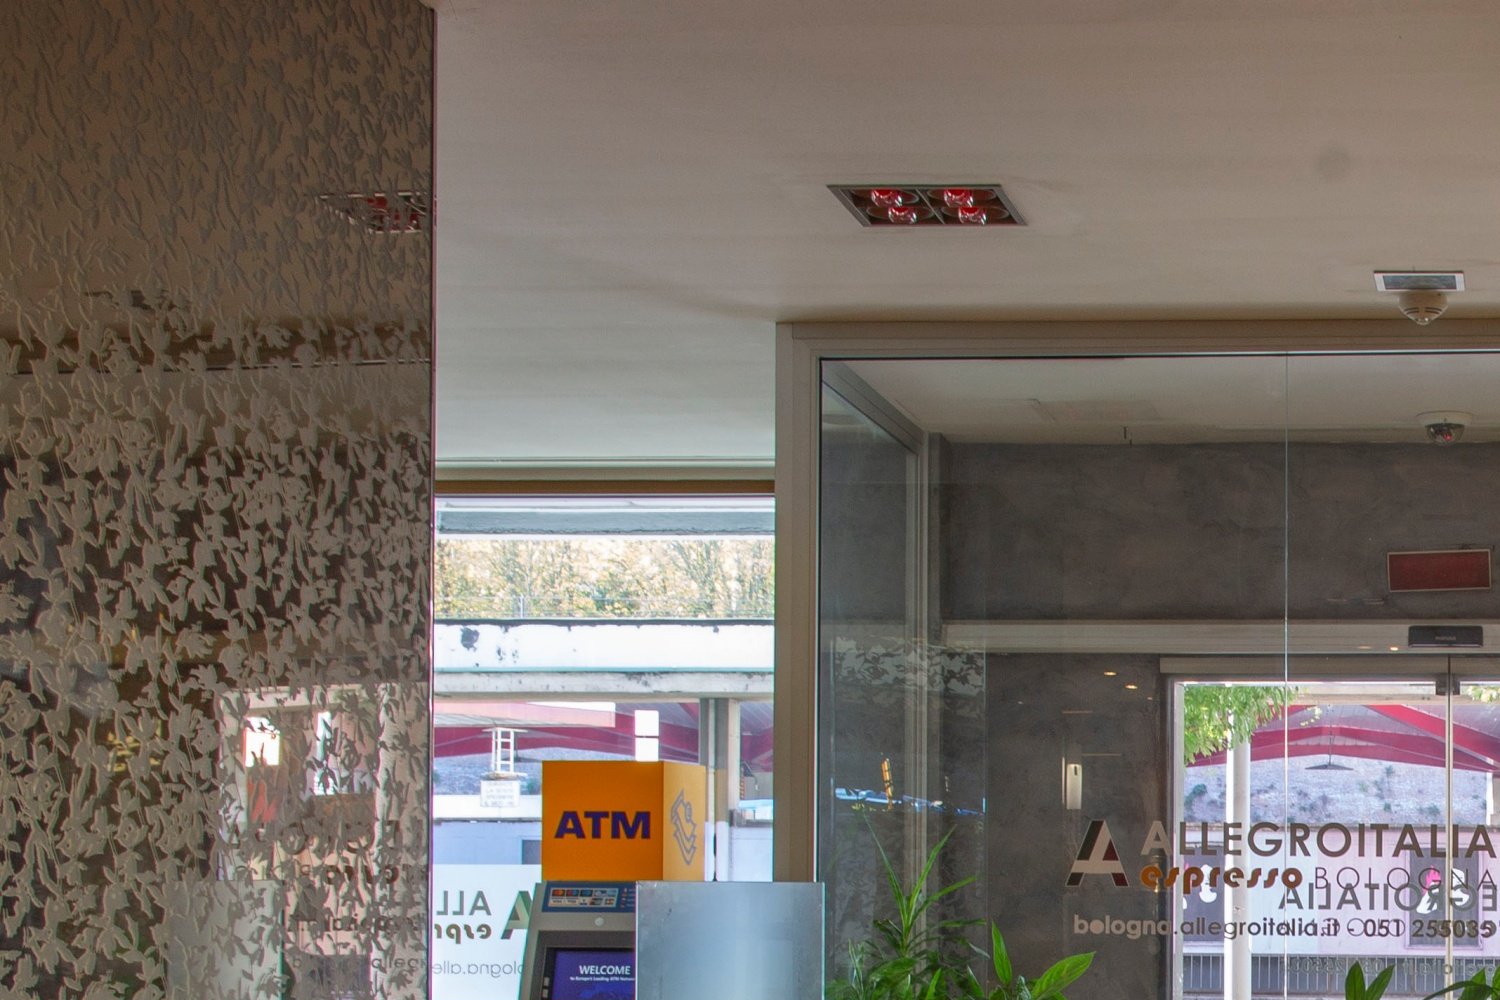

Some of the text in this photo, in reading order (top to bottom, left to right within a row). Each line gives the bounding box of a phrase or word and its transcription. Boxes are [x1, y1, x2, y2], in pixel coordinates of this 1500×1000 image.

[554, 810, 652, 840] ATM
[1141, 820, 1497, 858] ALLEGROITALIA
[1140, 866, 1497, 894] espresso BOLOGNA
[1364, 918, 1400, 938] 051
[579, 965, 631, 975] WELCOME
